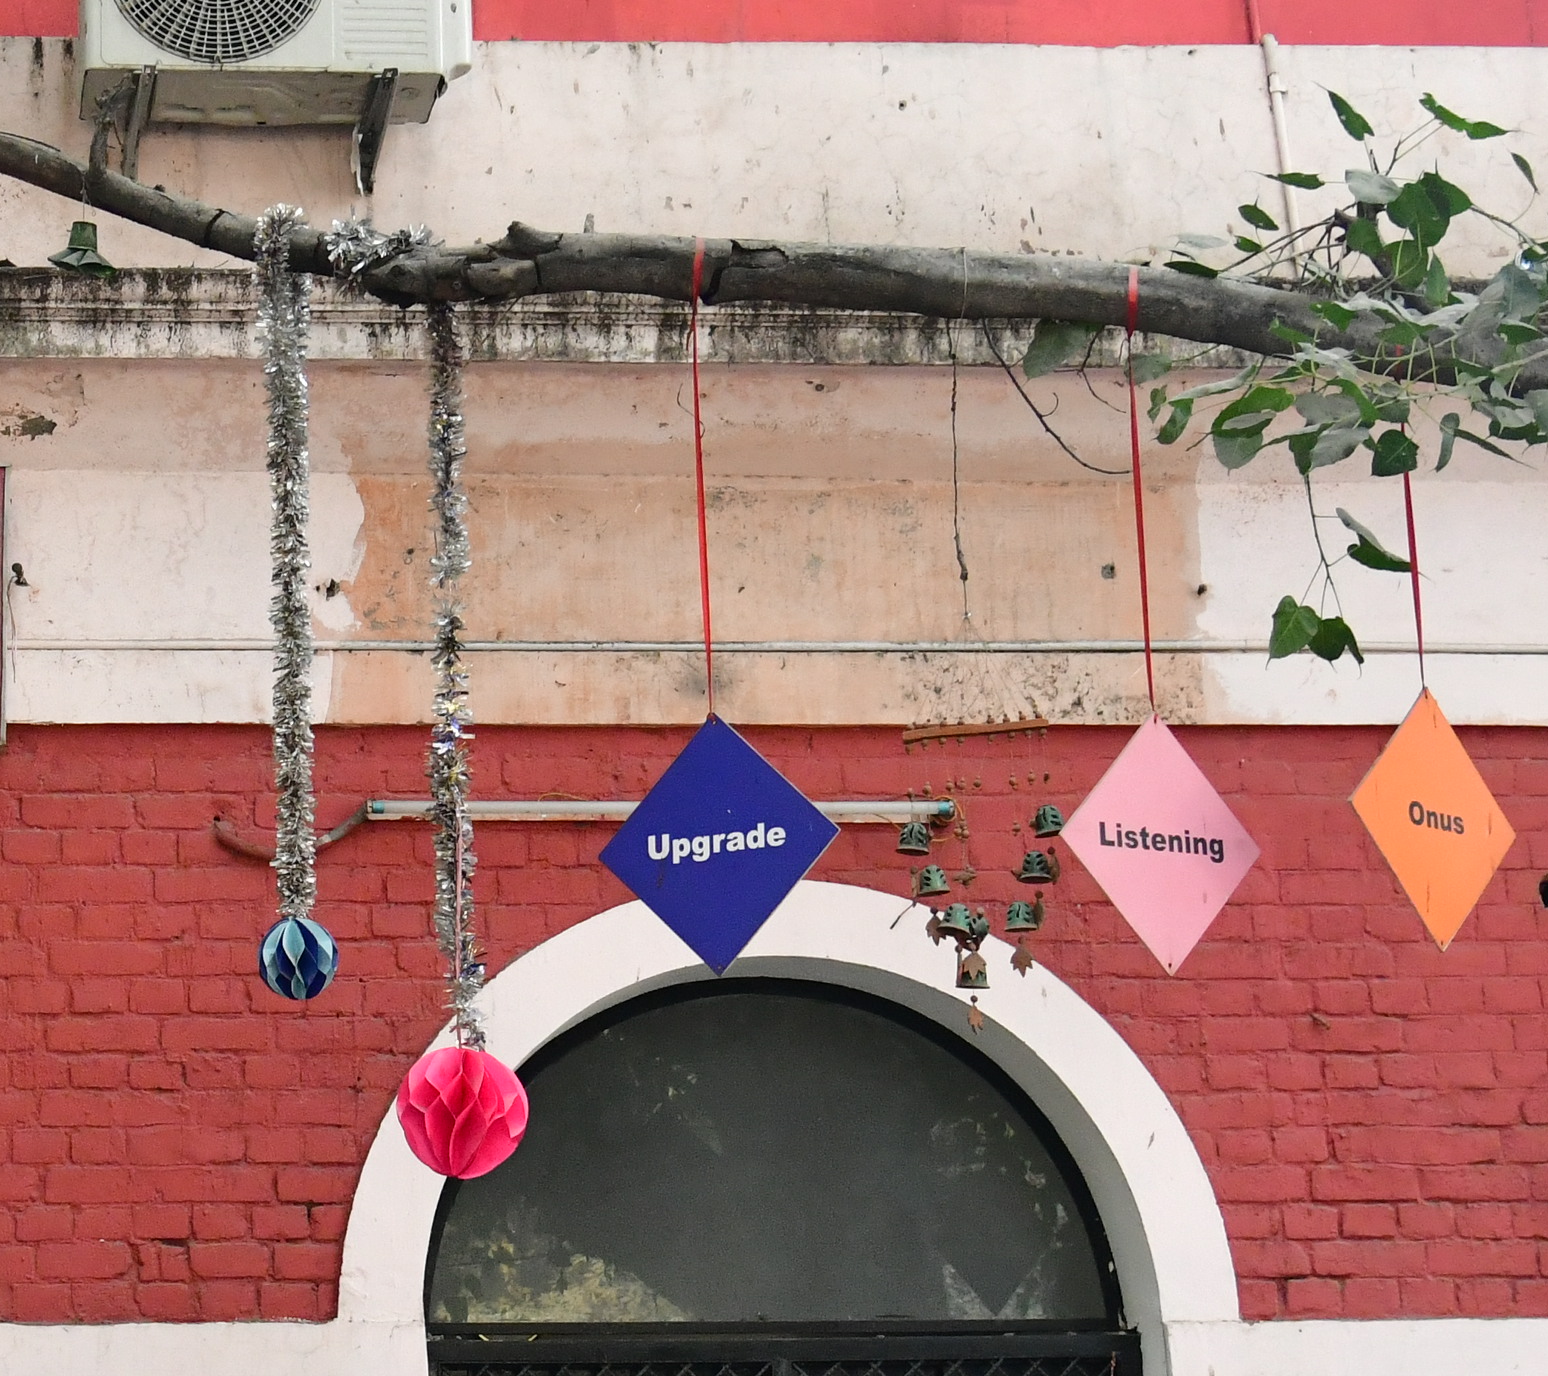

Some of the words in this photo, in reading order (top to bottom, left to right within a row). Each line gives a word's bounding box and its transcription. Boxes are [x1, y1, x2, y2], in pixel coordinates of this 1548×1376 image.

[1409, 801, 1464, 834] Onus
[648, 823, 786, 864] Upgrade
[1100, 822, 1224, 863] Listening
